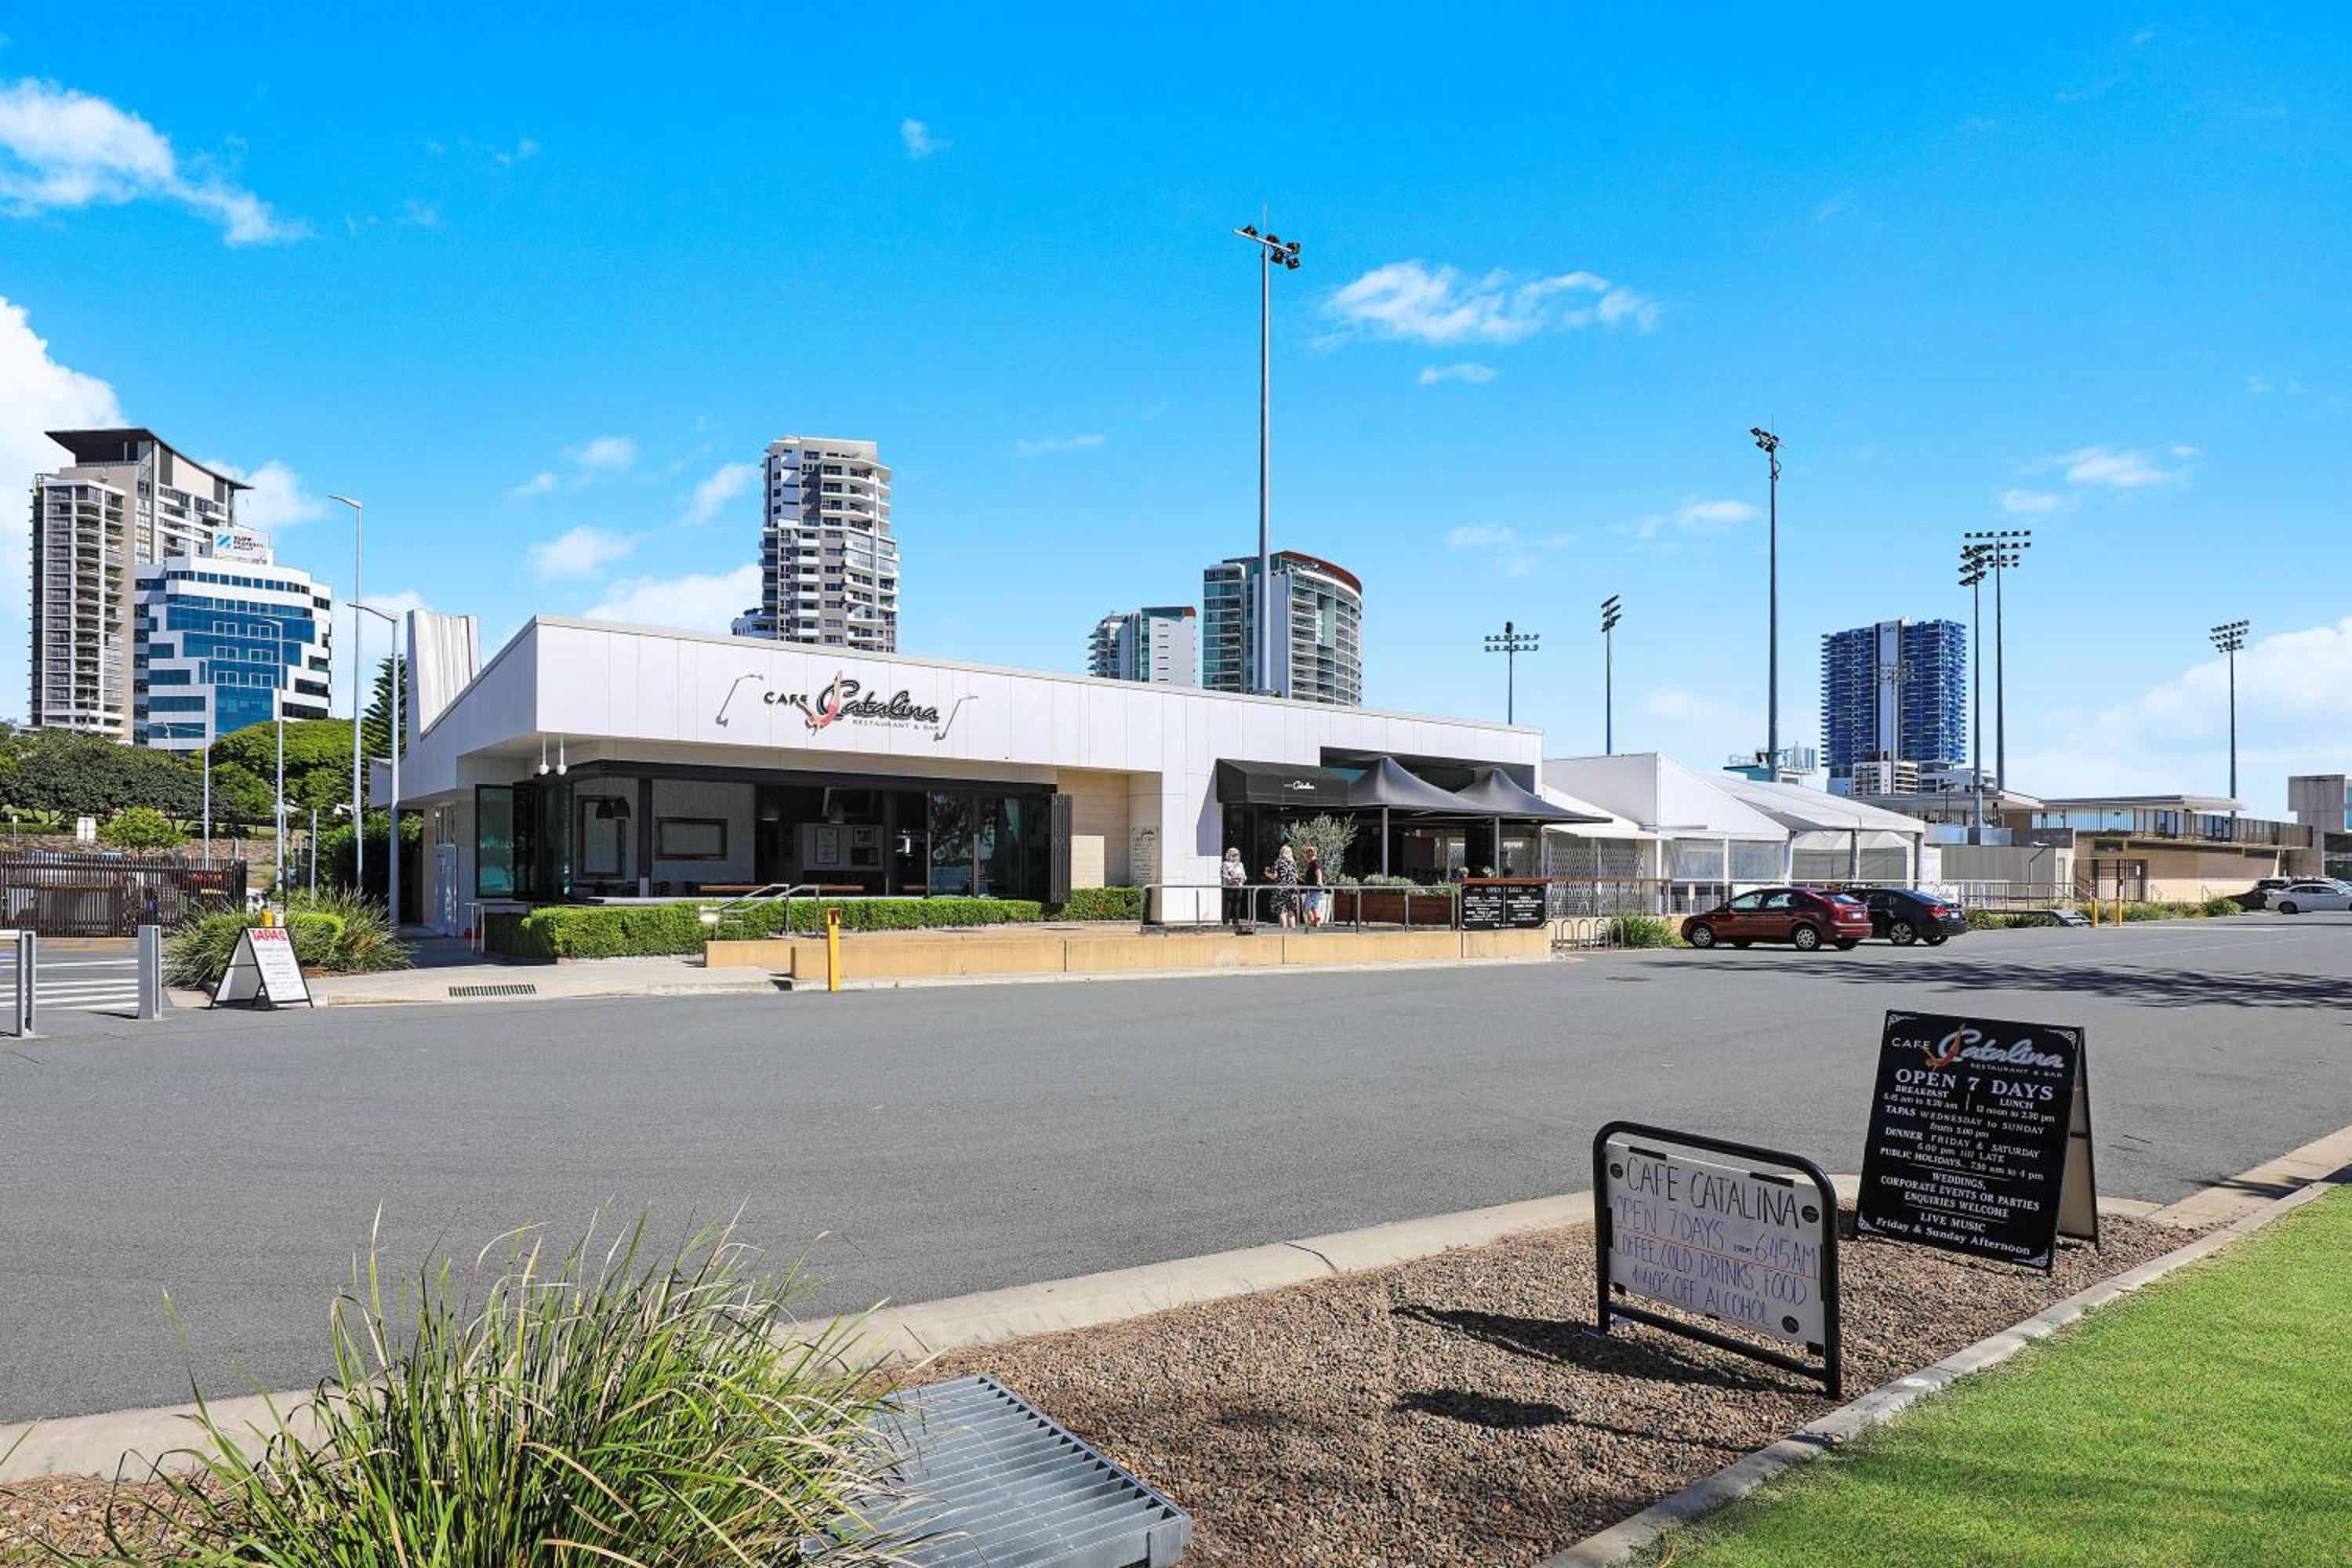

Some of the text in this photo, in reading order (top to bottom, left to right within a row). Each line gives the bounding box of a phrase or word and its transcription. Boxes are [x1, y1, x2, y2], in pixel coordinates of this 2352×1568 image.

[764, 680, 940, 723] CAFE Catalina
[853, 719, 909, 728] RESTAURANT
[249, 929, 288, 941] TAPAS
[1892, 1029, 2064, 1069] CAFE Catalina
[1970, 1062, 2028, 1075] RESTAURANT
[1895, 1085, 1949, 1098] BREAKFAST
[1896, 1069, 2054, 1100] OPEN 7 DAYS
[1986, 1108, 2008, 1116] noon
[2041, 1115, 2055, 1123] pm
[2000, 1098, 2034, 1109] LUNCH
[1885, 1105, 1916, 1116] TAPAS
[1921, 1111, 1983, 1126] WEDNESDAY
[2002, 1122, 2044, 1134] SUNDAY
[1929, 1122, 1953, 1133] from
[1885, 1127, 2040, 1158] DINNER FRIDAY & SATURDAY
[1940, 1147, 1956, 1156] pm
[1960, 1149, 1975, 1159] till
[1979, 1152, 2005, 1163] LATE
[1879, 1147, 1912, 1160] PUBLIC
[1915, 1152, 1961, 1167] HOLIDAYS
[2019, 1168, 2025, 1178] 4
[2028, 1172, 2044, 1181] pm
[1627, 1156, 1799, 1230] CAFE CATALINA
[1881, 1175, 2040, 1211] CORPORATE EVENTS OR PARTIES
[1933, 1173, 1986, 1191] WEDDINGS,
[1614, 1195, 1657, 1234] OPEN
[1904, 1192, 2009, 1218] ENQUIRIES WELCOME
[1875, 1217, 2031, 1255] Friday & Sunday Afternoon
[1920, 1212, 1986, 1233] LIVE MUSIC
[1661, 1243, 1693, 1274] COLD
[1764, 1269, 1807, 1306] FOOD
[1672, 1276, 1694, 1305] OFF
[1704, 1286, 1769, 1325] ALCOHOL
